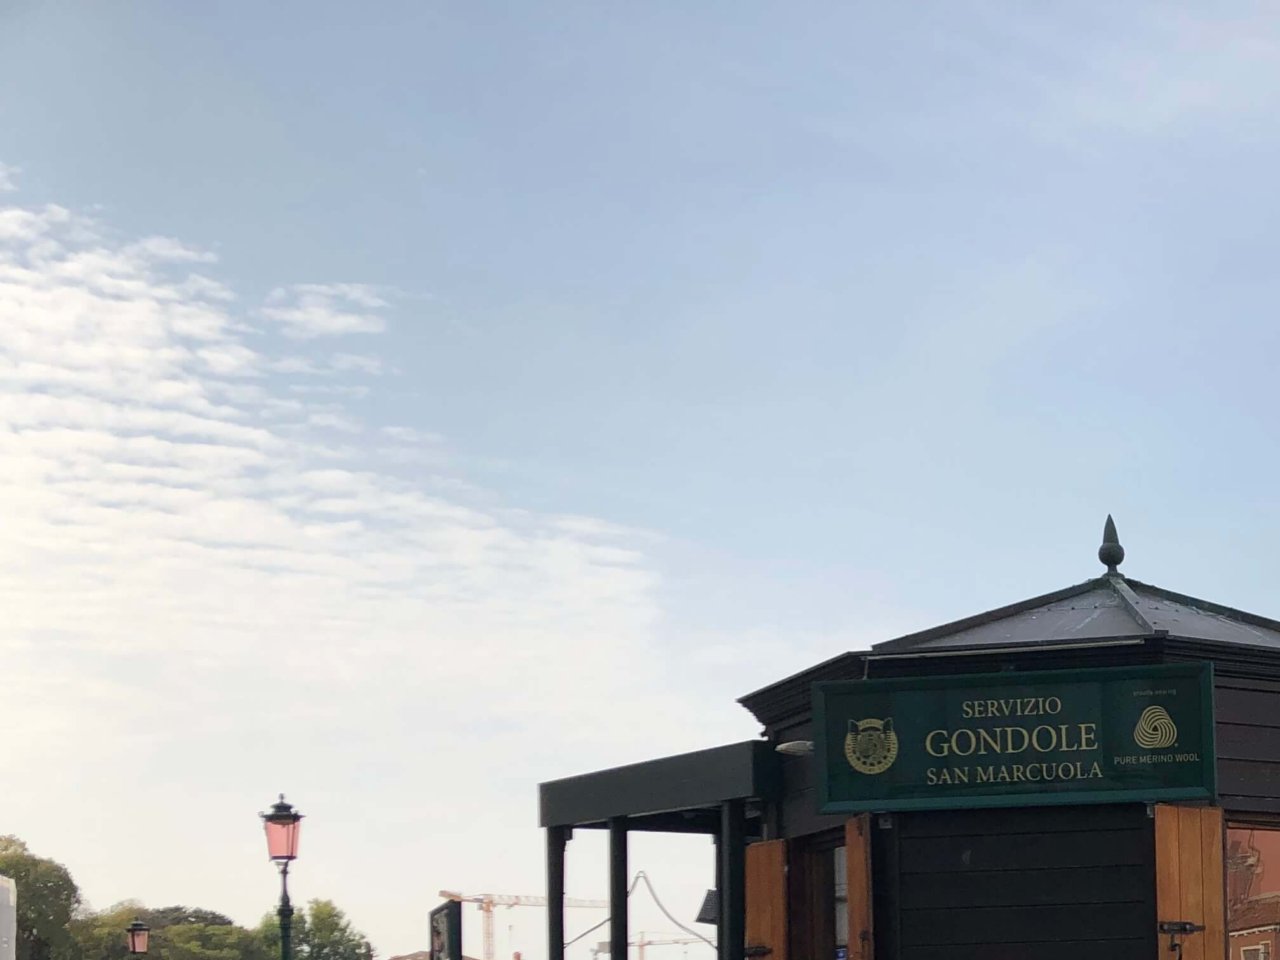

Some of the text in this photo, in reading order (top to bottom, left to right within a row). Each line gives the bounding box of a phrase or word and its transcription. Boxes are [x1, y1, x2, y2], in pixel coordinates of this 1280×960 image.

[962, 696, 1061, 719] SERVIZIO
[925, 723, 1098, 757] GONDOLE
[1113, 752, 1200, 765] PURE MERINO WOOL
[926, 761, 1103, 785] SAN MARCUOLA
